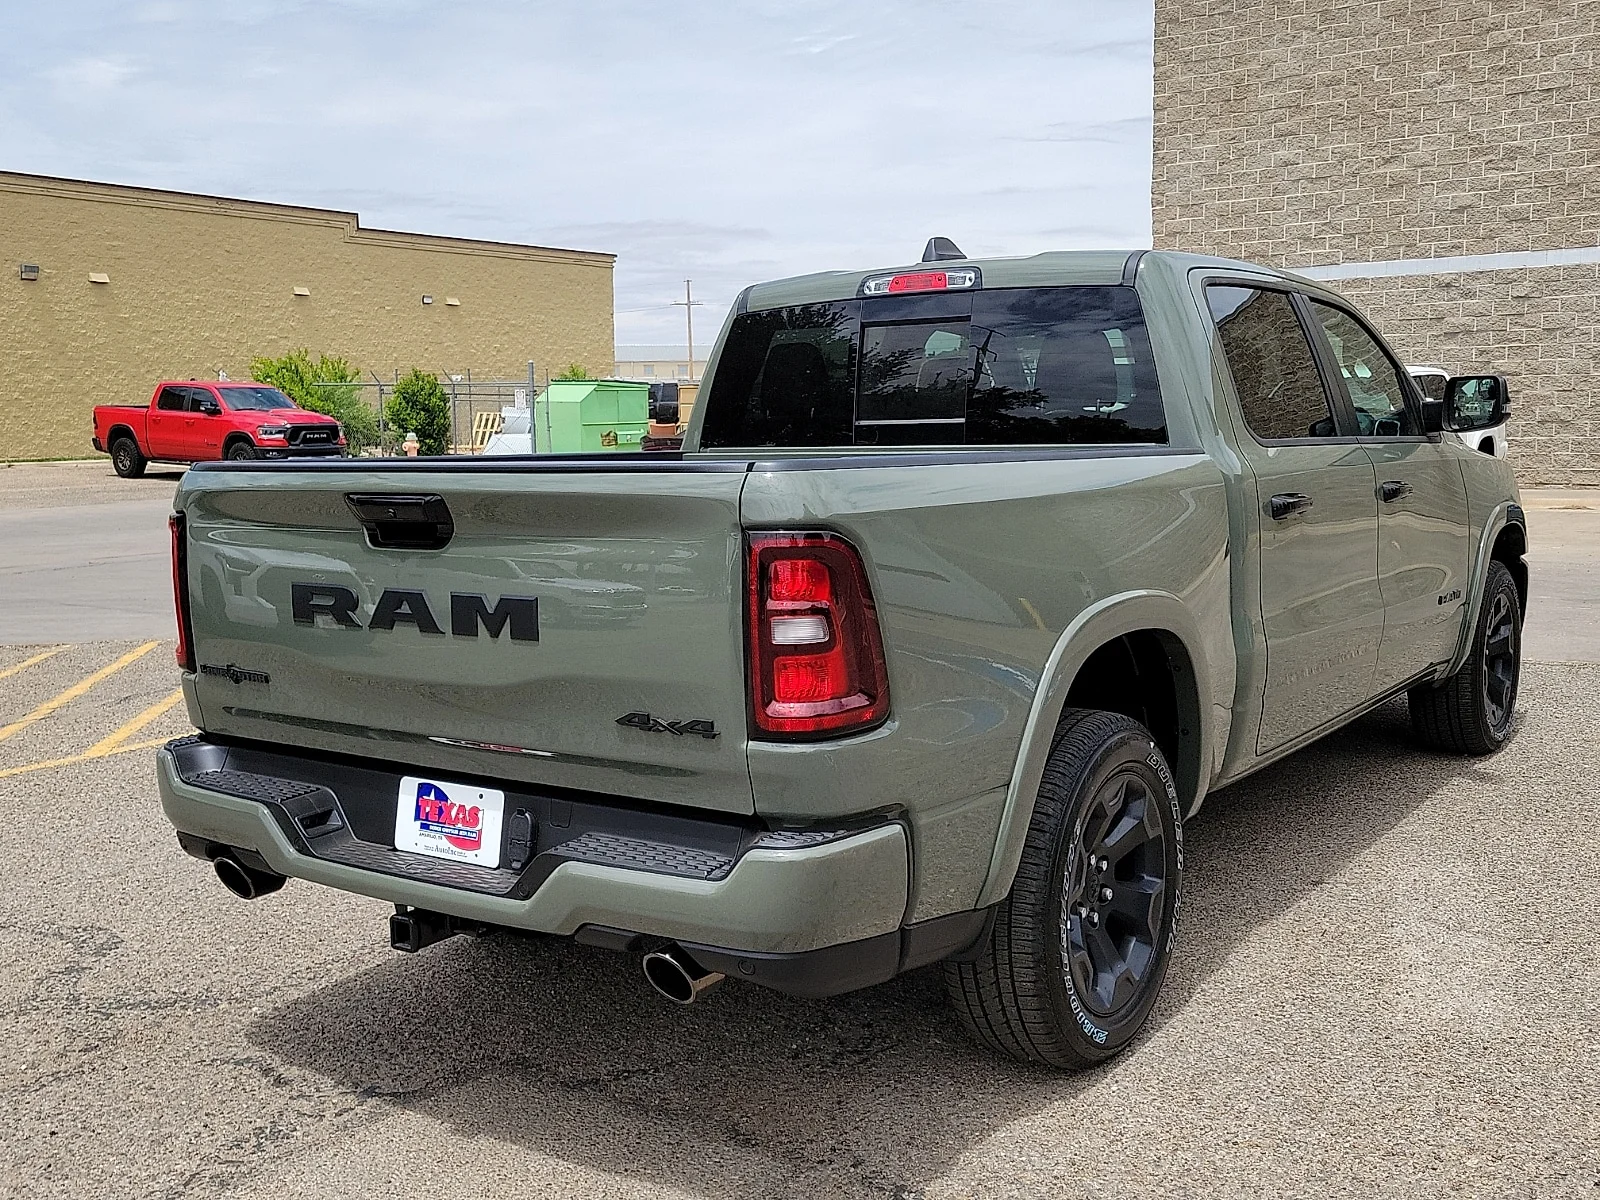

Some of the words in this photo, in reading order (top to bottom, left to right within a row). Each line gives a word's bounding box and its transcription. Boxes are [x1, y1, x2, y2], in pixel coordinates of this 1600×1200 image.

[291, 581, 540, 642] RAM
[418, 797, 480, 829] TEXAS
[1146, 752, 1184, 871] DUELER
[1059, 817, 1108, 1045] BRIDGESTONE
